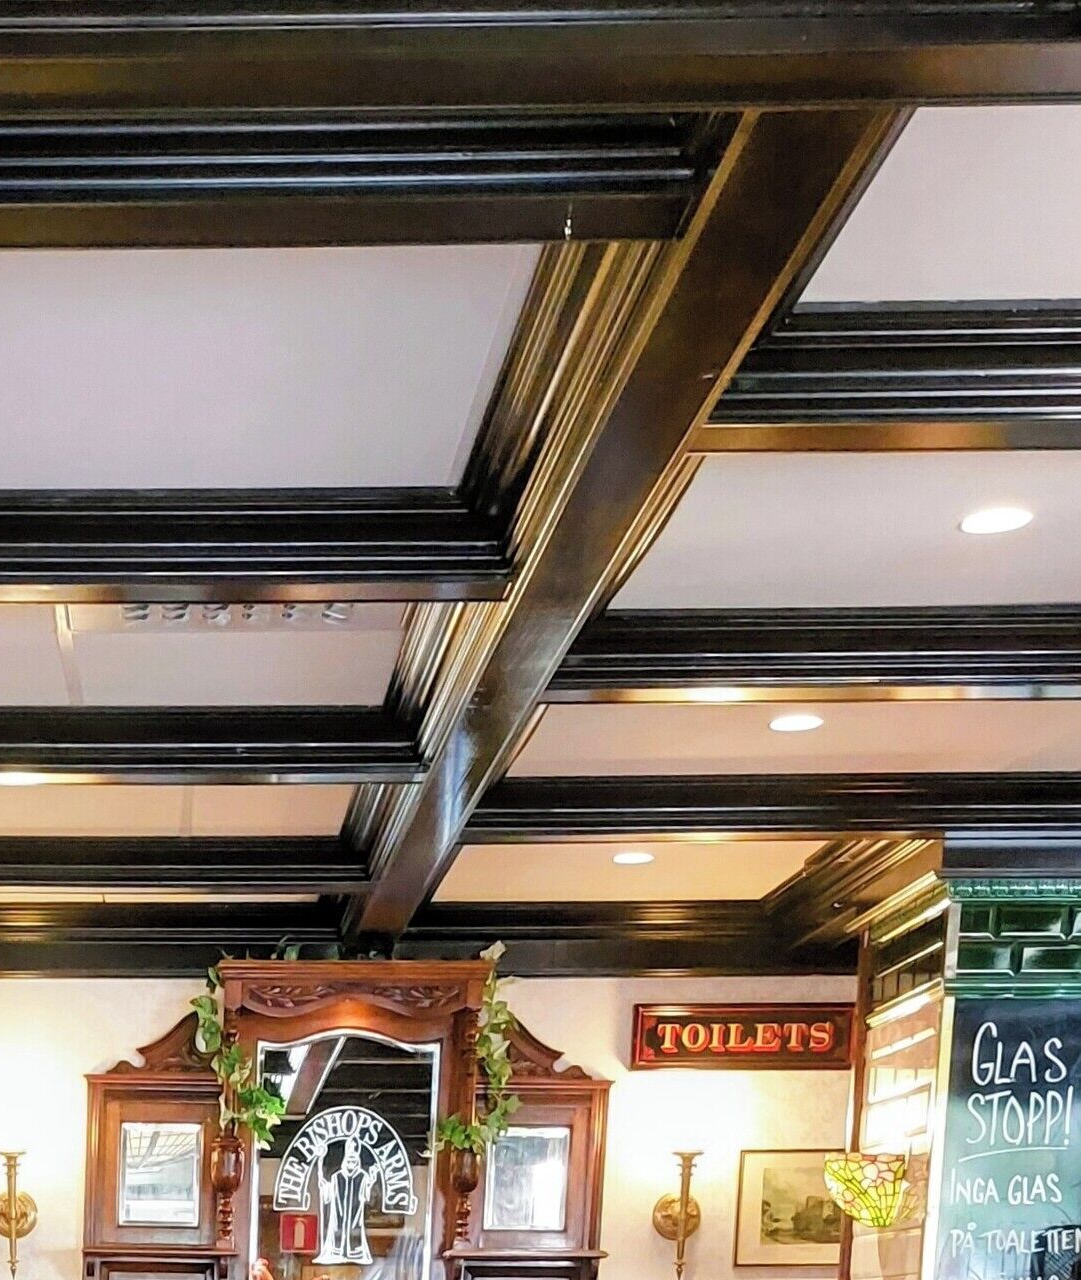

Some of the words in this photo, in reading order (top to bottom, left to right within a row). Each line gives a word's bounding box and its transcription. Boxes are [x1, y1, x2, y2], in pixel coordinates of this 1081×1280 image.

[657, 1021, 834, 1053] TOILETS
[972, 1022, 1067, 1086] GLAS
[966, 1086, 1074, 1146] STOPP!
[278, 1156, 310, 1204] THE
[374, 1139, 410, 1206] ARMS
[950, 1168, 1000, 1206] INGA
[1007, 1172, 1063, 1206] GLAS
[950, 1222, 977, 1258] PÅ
